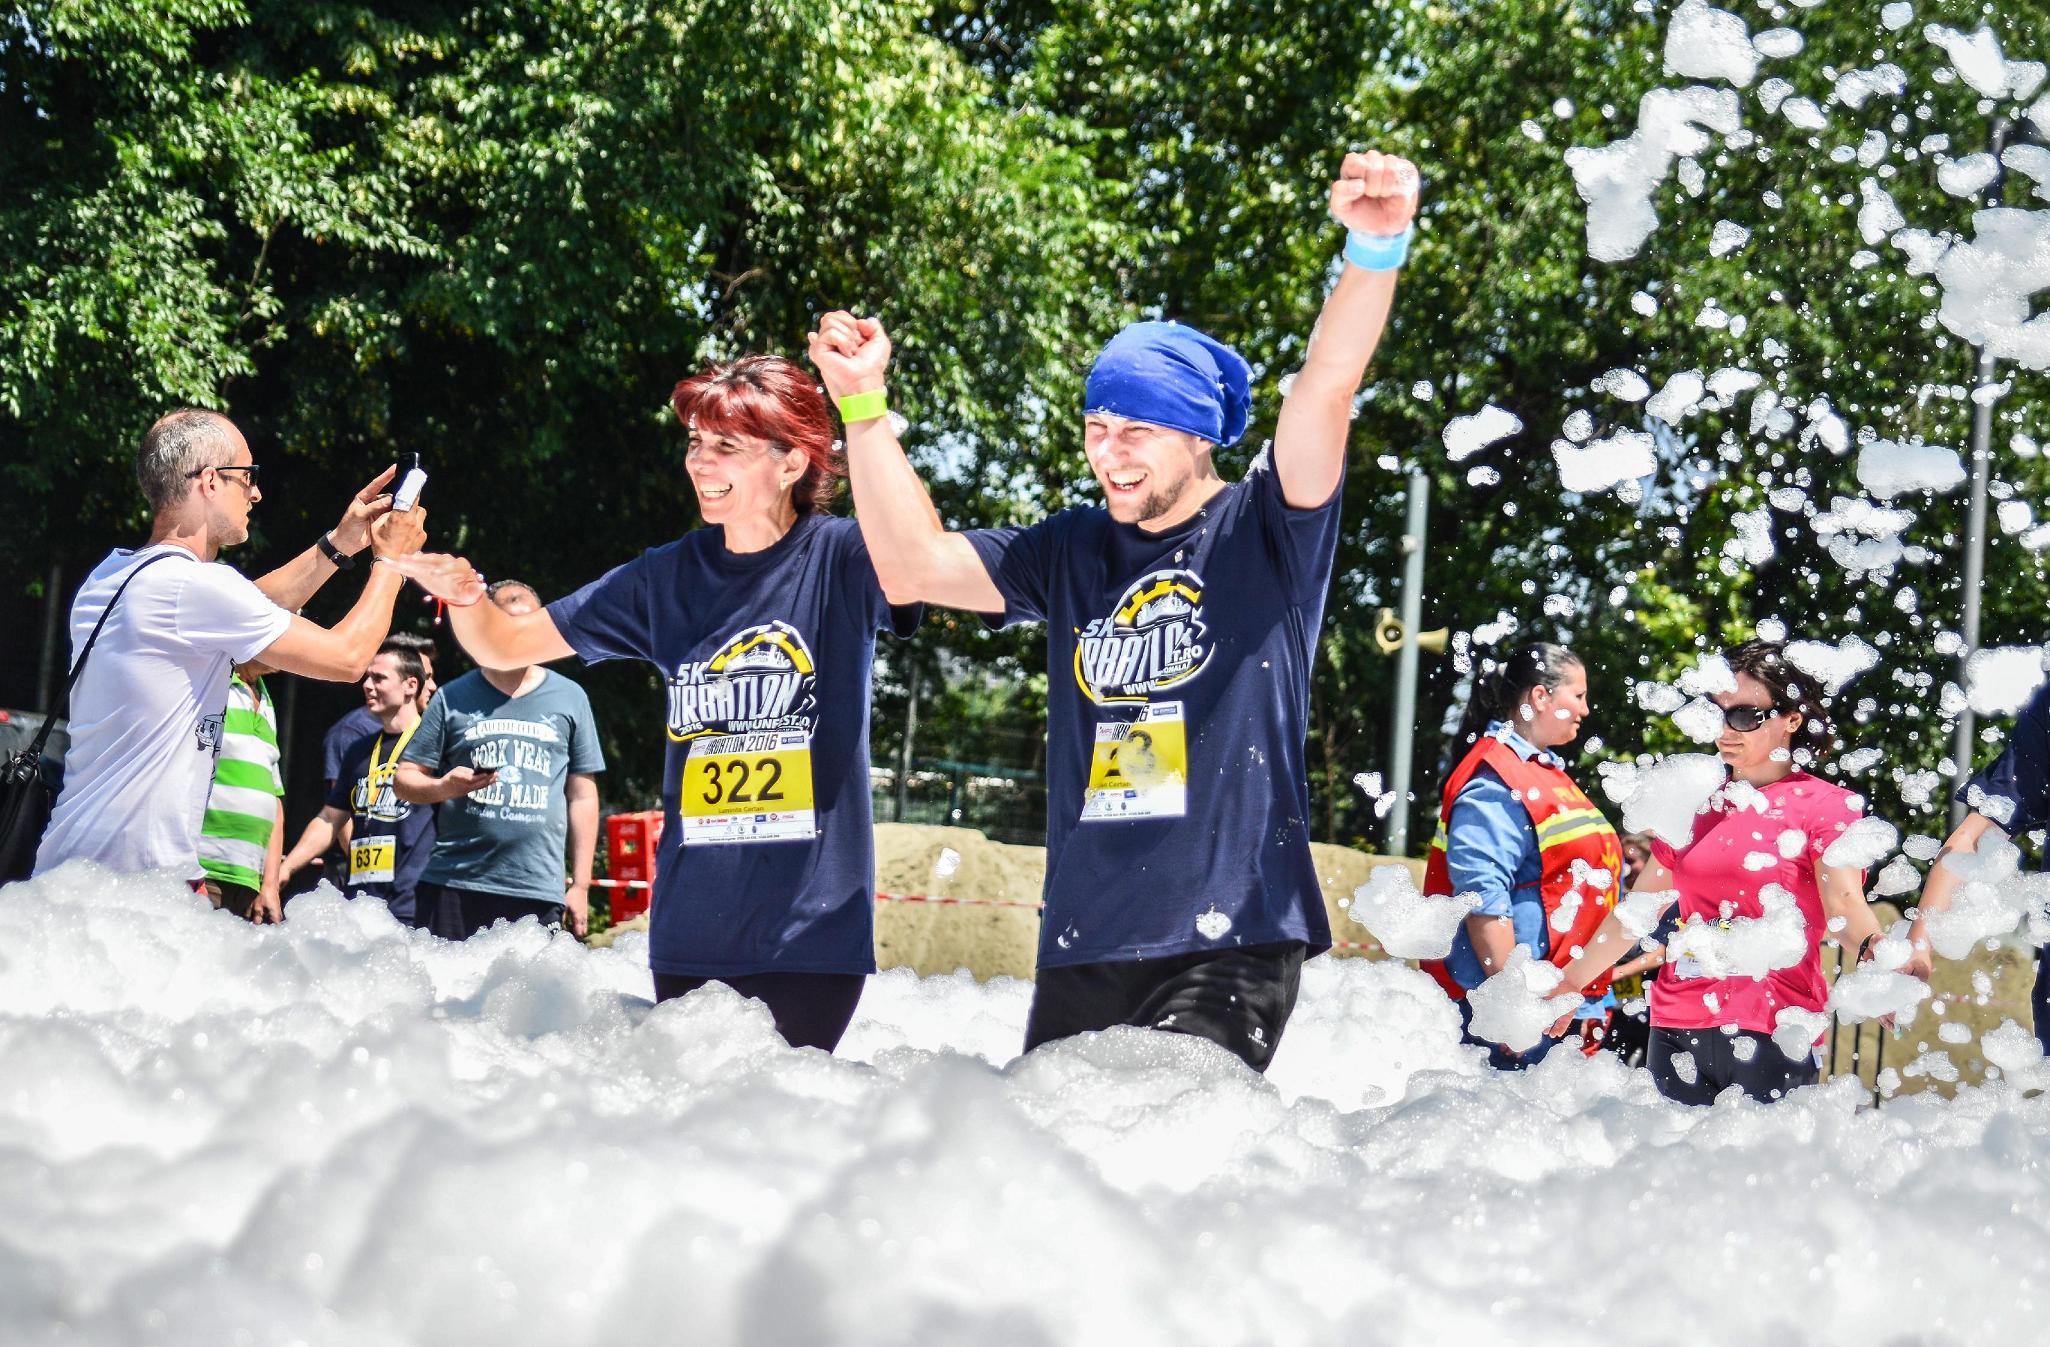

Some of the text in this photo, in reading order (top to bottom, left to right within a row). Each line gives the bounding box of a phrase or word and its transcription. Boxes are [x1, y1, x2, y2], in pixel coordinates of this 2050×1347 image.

[1081, 618, 1114, 637] 5K
[677, 661, 707, 685] 5K
[669, 672, 802, 729] URBATLON
[679, 721, 704, 735] 2016
[746, 732, 779, 752] 2016
[513, 739, 552, 778] WEAR
[703, 758, 784, 805] 322
[508, 782, 549, 810] MADE
[356, 848, 382, 868] 637
